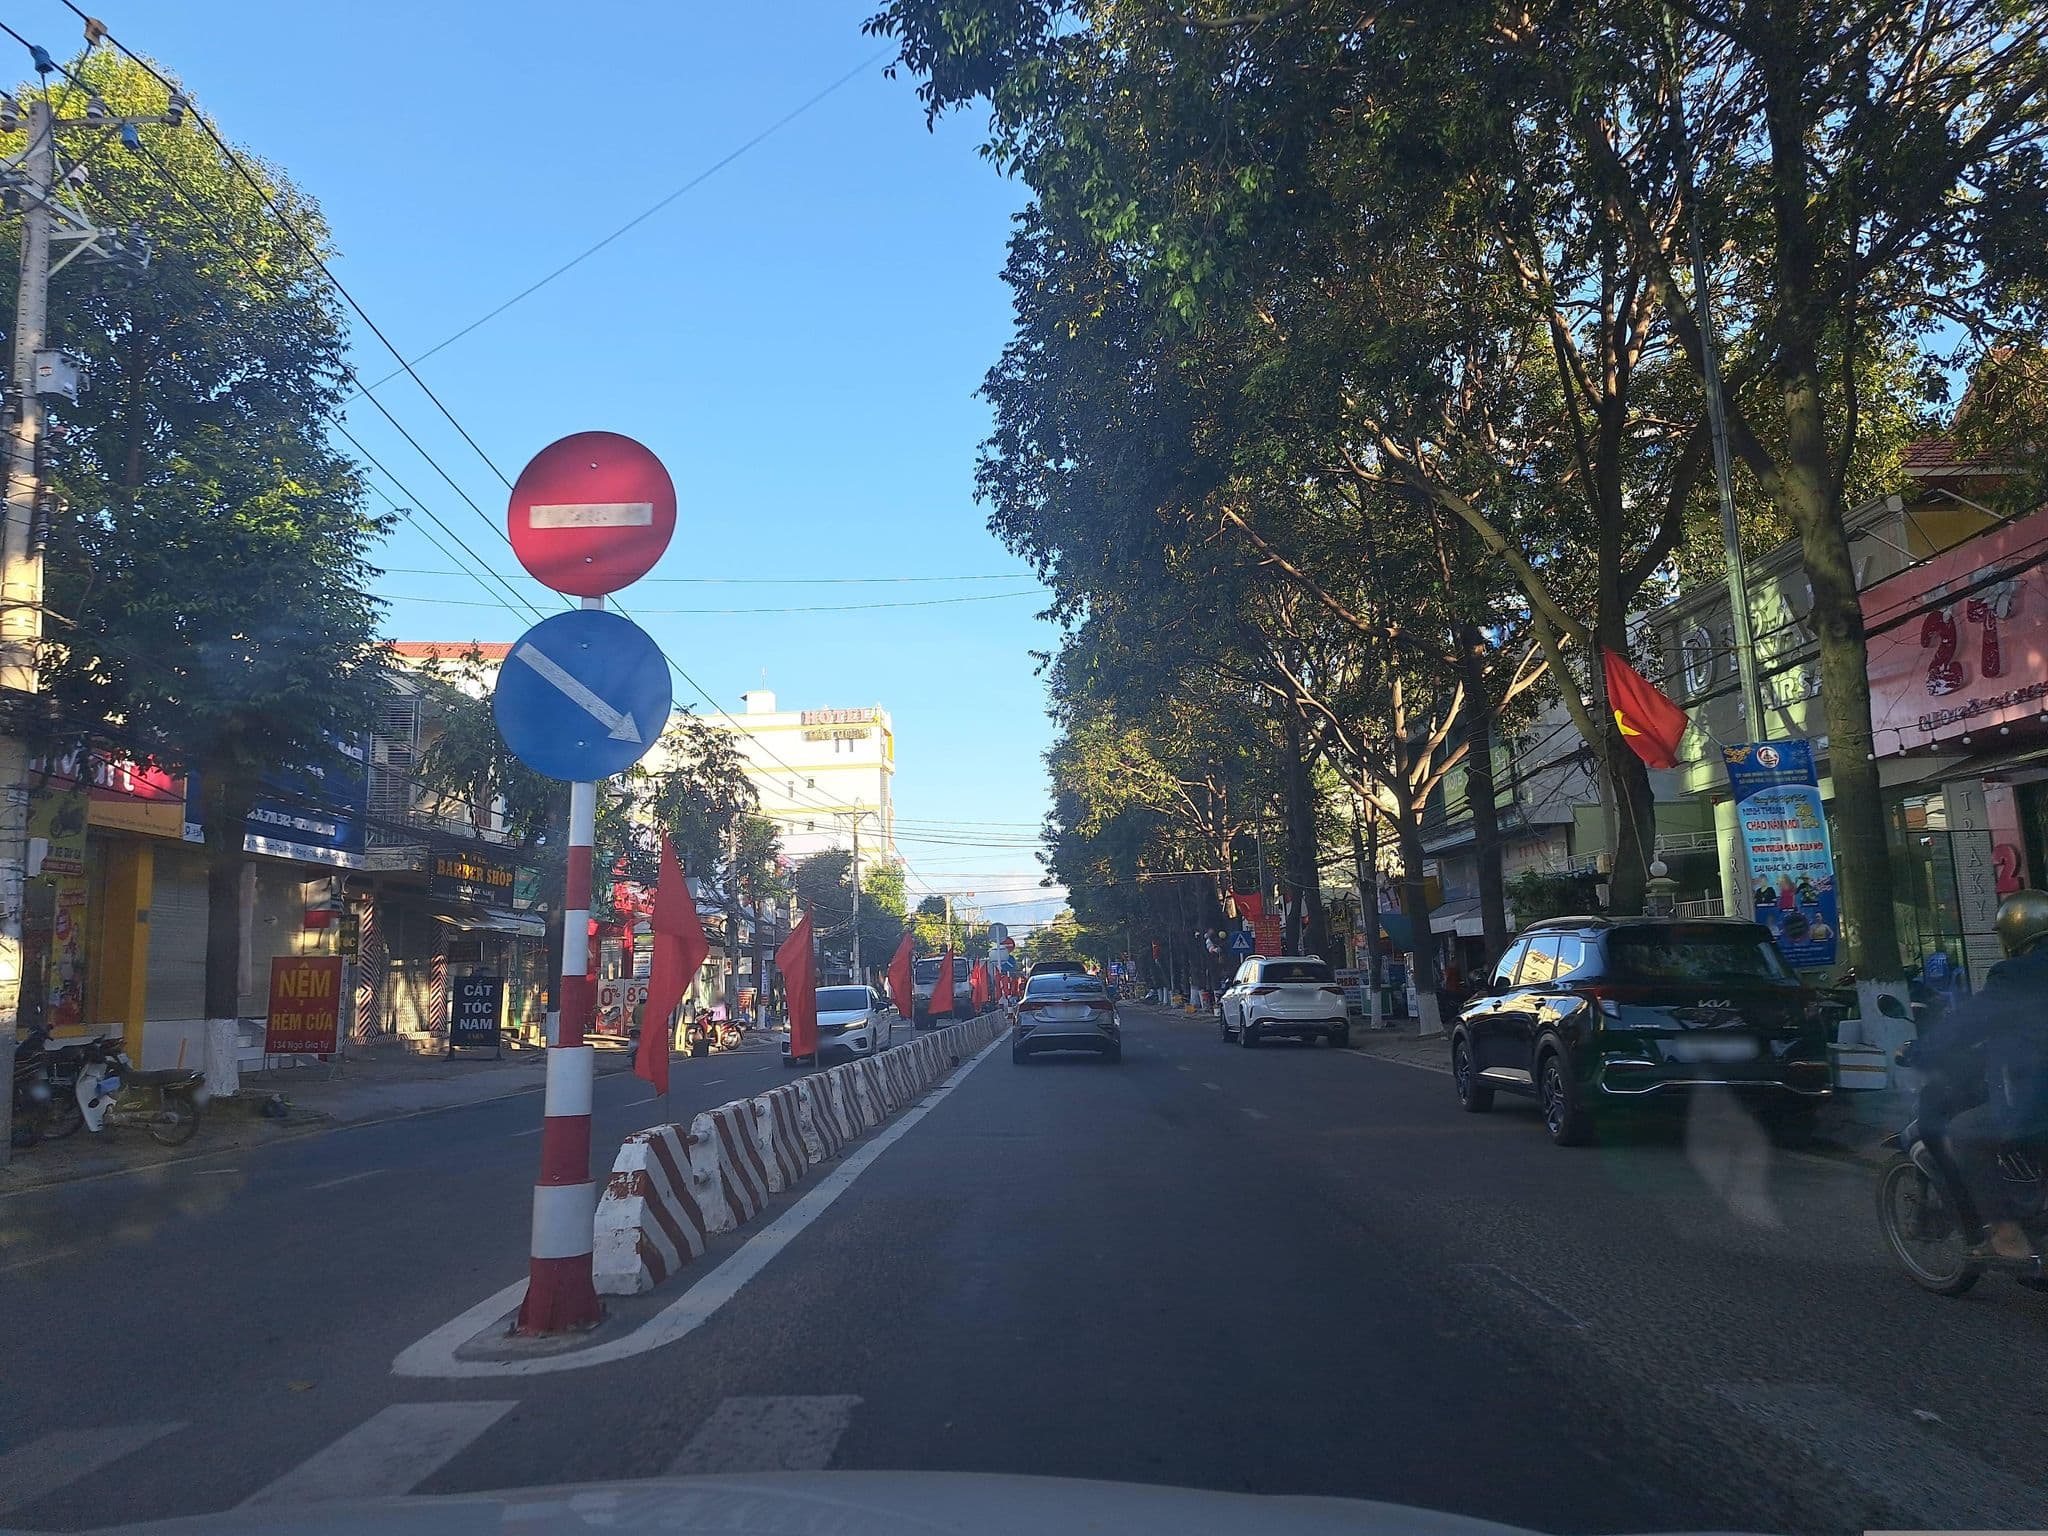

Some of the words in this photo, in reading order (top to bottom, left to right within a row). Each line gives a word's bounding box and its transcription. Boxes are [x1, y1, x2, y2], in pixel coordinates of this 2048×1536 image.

[803, 708, 873, 726] HOTEL
[1960, 791, 1985, 922] TRAKY
[437, 858, 484, 882] BARBER
[486, 868, 513, 887] SHOP
[278, 961, 332, 1007] NỆM
[463, 980, 493, 996] CẮT
[462, 999, 493, 1014] TÓC
[271, 1008, 300, 1031] RÈM
[306, 1007, 333, 1031] CỬA
[460, 1018, 493, 1030] NAM
[273, 1040, 286, 1049] 134
[288, 1040, 303, 1051] Ngô
[305, 1040, 318, 1049] Gia
